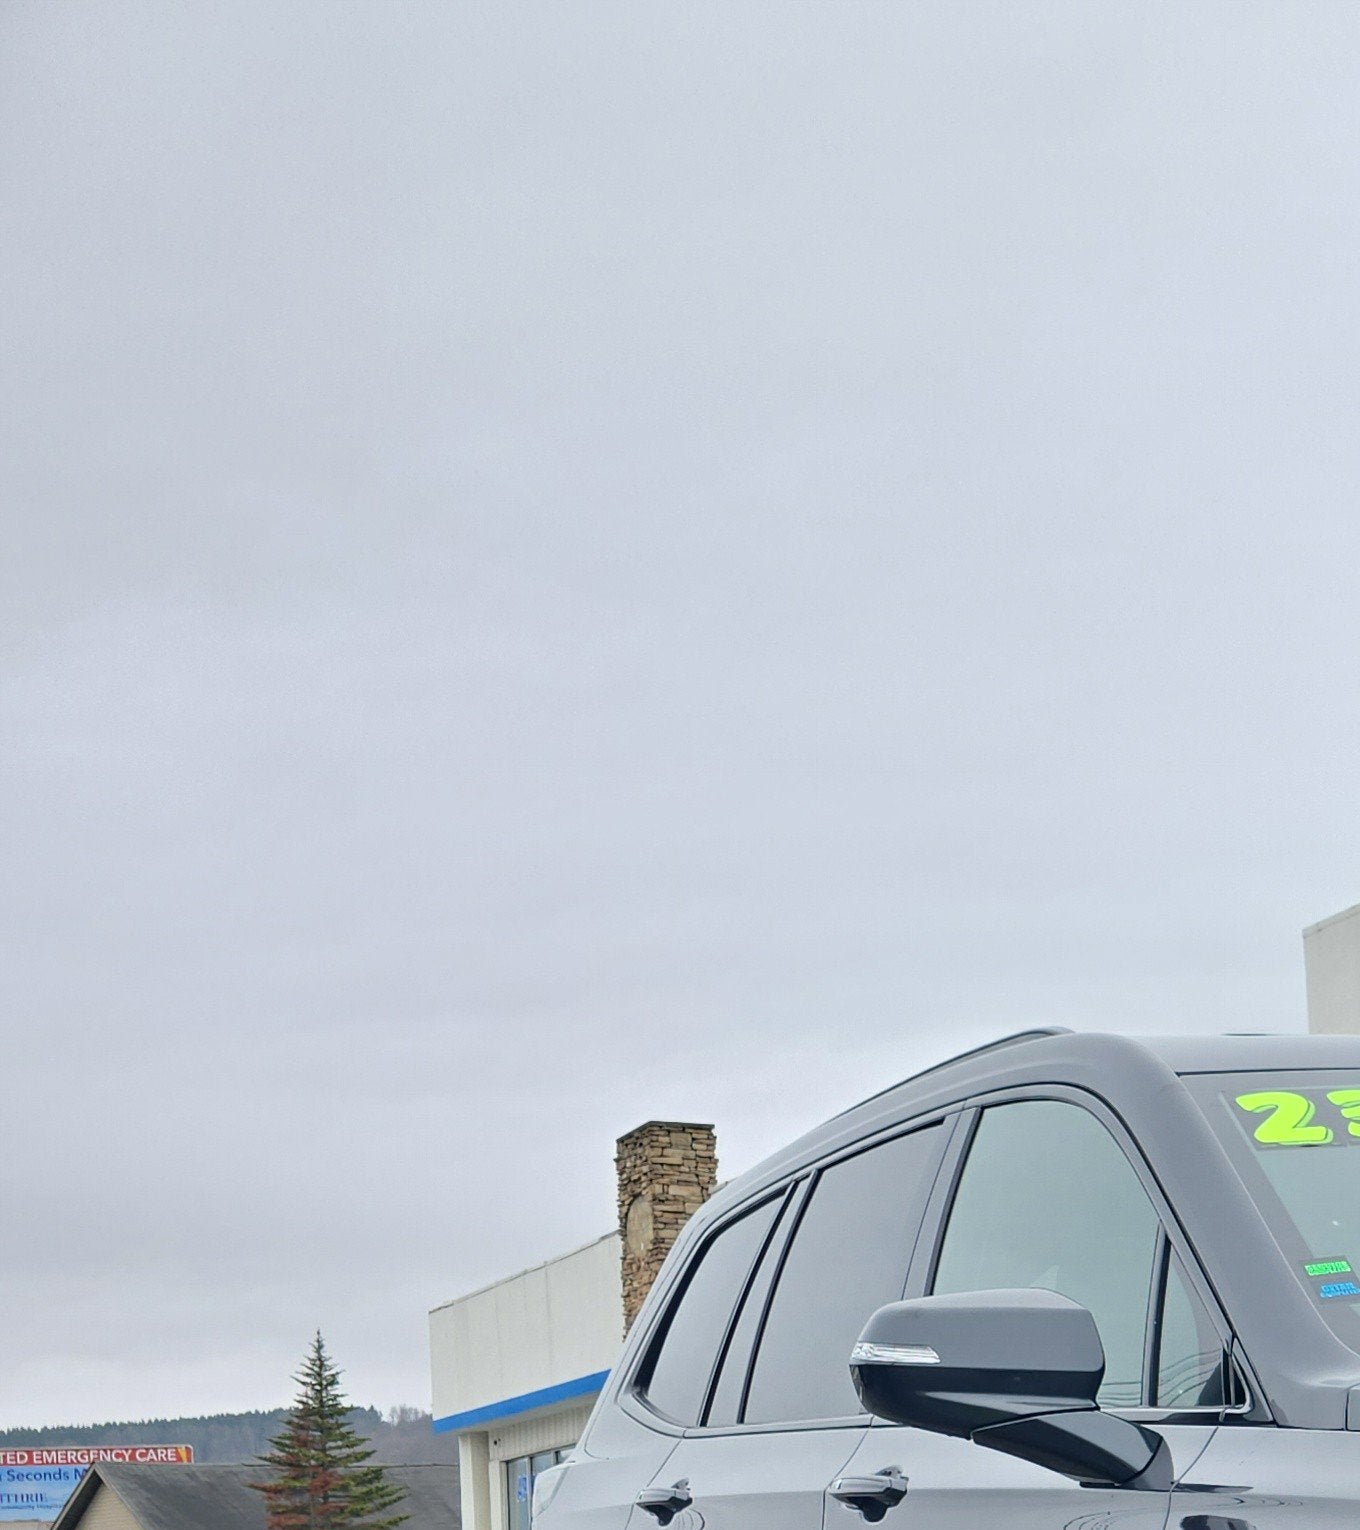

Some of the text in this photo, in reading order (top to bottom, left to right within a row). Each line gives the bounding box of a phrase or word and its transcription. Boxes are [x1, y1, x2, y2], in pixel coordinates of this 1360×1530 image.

[33, 1449, 132, 1464] EMERGENCY
[135, 1448, 177, 1462] CARE
[6, 1468, 69, 1482] Seconds
